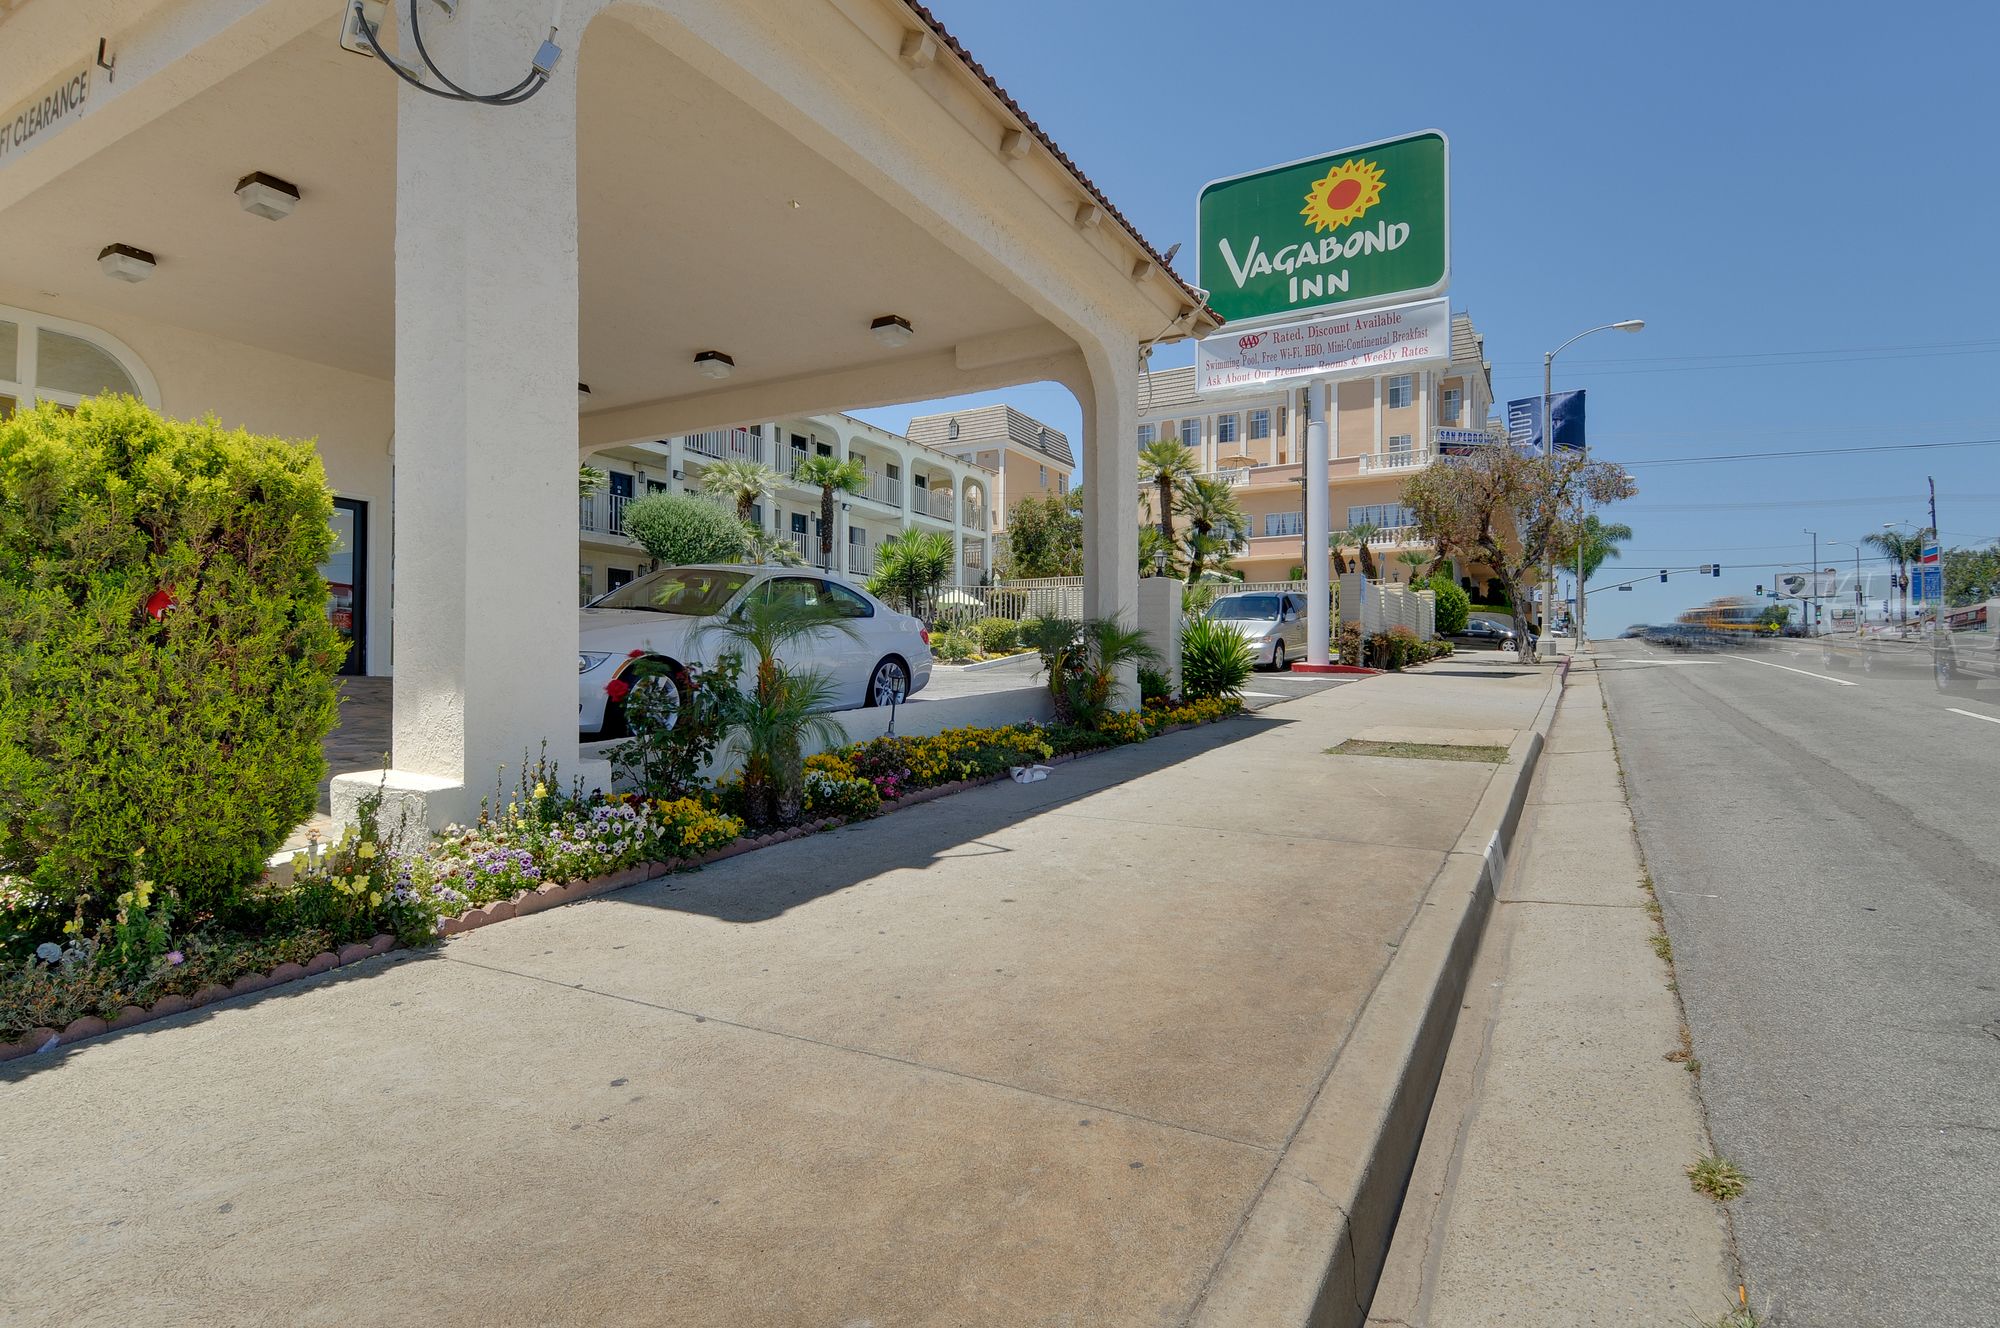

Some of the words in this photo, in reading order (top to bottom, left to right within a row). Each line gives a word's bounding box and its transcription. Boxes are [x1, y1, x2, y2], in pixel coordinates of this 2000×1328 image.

[97, 37, 116, 83] 4
[0, 123, 12, 156] FT
[14, 70, 87, 146] CLEARANCE
[1218, 220, 1410, 289] VAGABOND
[1289, 269, 1349, 303] INN
[1206, 357, 1240, 370] Swimming
[1262, 351, 1277, 363] Free
[1328, 332, 1390, 353] Mini-Continental
[1392, 327, 1428, 343] Breakfast
[1240, 335, 1258, 349] AAA
[1308, 322, 1350, 338] Discount
[1355, 312, 1402, 331] Available
[1206, 374, 1222, 386] Ask
[1225, 372, 1250, 384] About
[1254, 369, 1271, 379] Our
[1274, 363, 1314, 377] Premium
[1318, 358, 1348, 371] Rooms
[1351, 355, 1358, 366] &
[1364, 348, 1397, 363] Weekly
[1401, 345, 1429, 358] Rates
[1440, 430, 1456, 441] SAN
[1458, 432, 1483, 443] PEDRO
[1510, 402, 1533, 446] ADOPT
